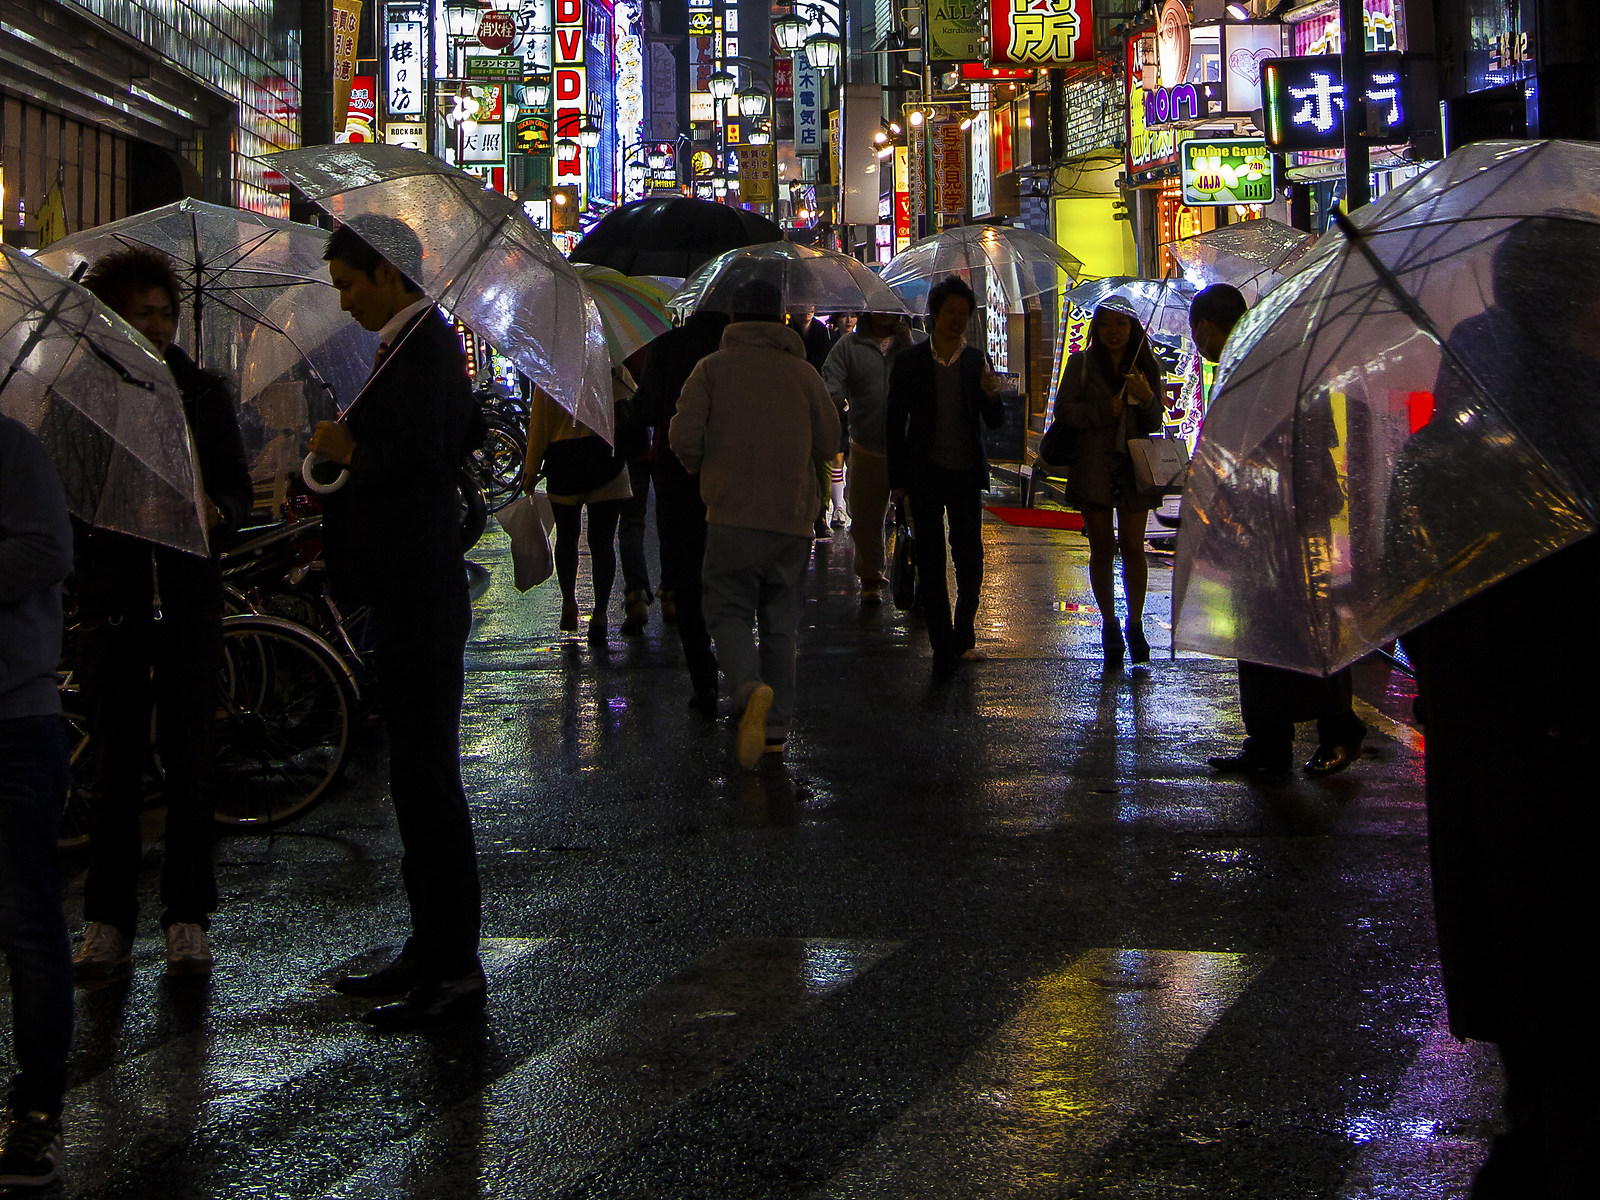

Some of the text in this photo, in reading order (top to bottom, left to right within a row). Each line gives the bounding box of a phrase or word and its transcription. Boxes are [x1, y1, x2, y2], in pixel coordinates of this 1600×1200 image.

[480, 21, 514, 39] 消火栓
[391, 128, 423, 136] ROCK BAR
[463, 133, 501, 152] 天照
[1190, 145, 1267, 158] Online Game
[1249, 162, 1263, 170] 24h
[1198, 175, 1221, 190] JAJA
